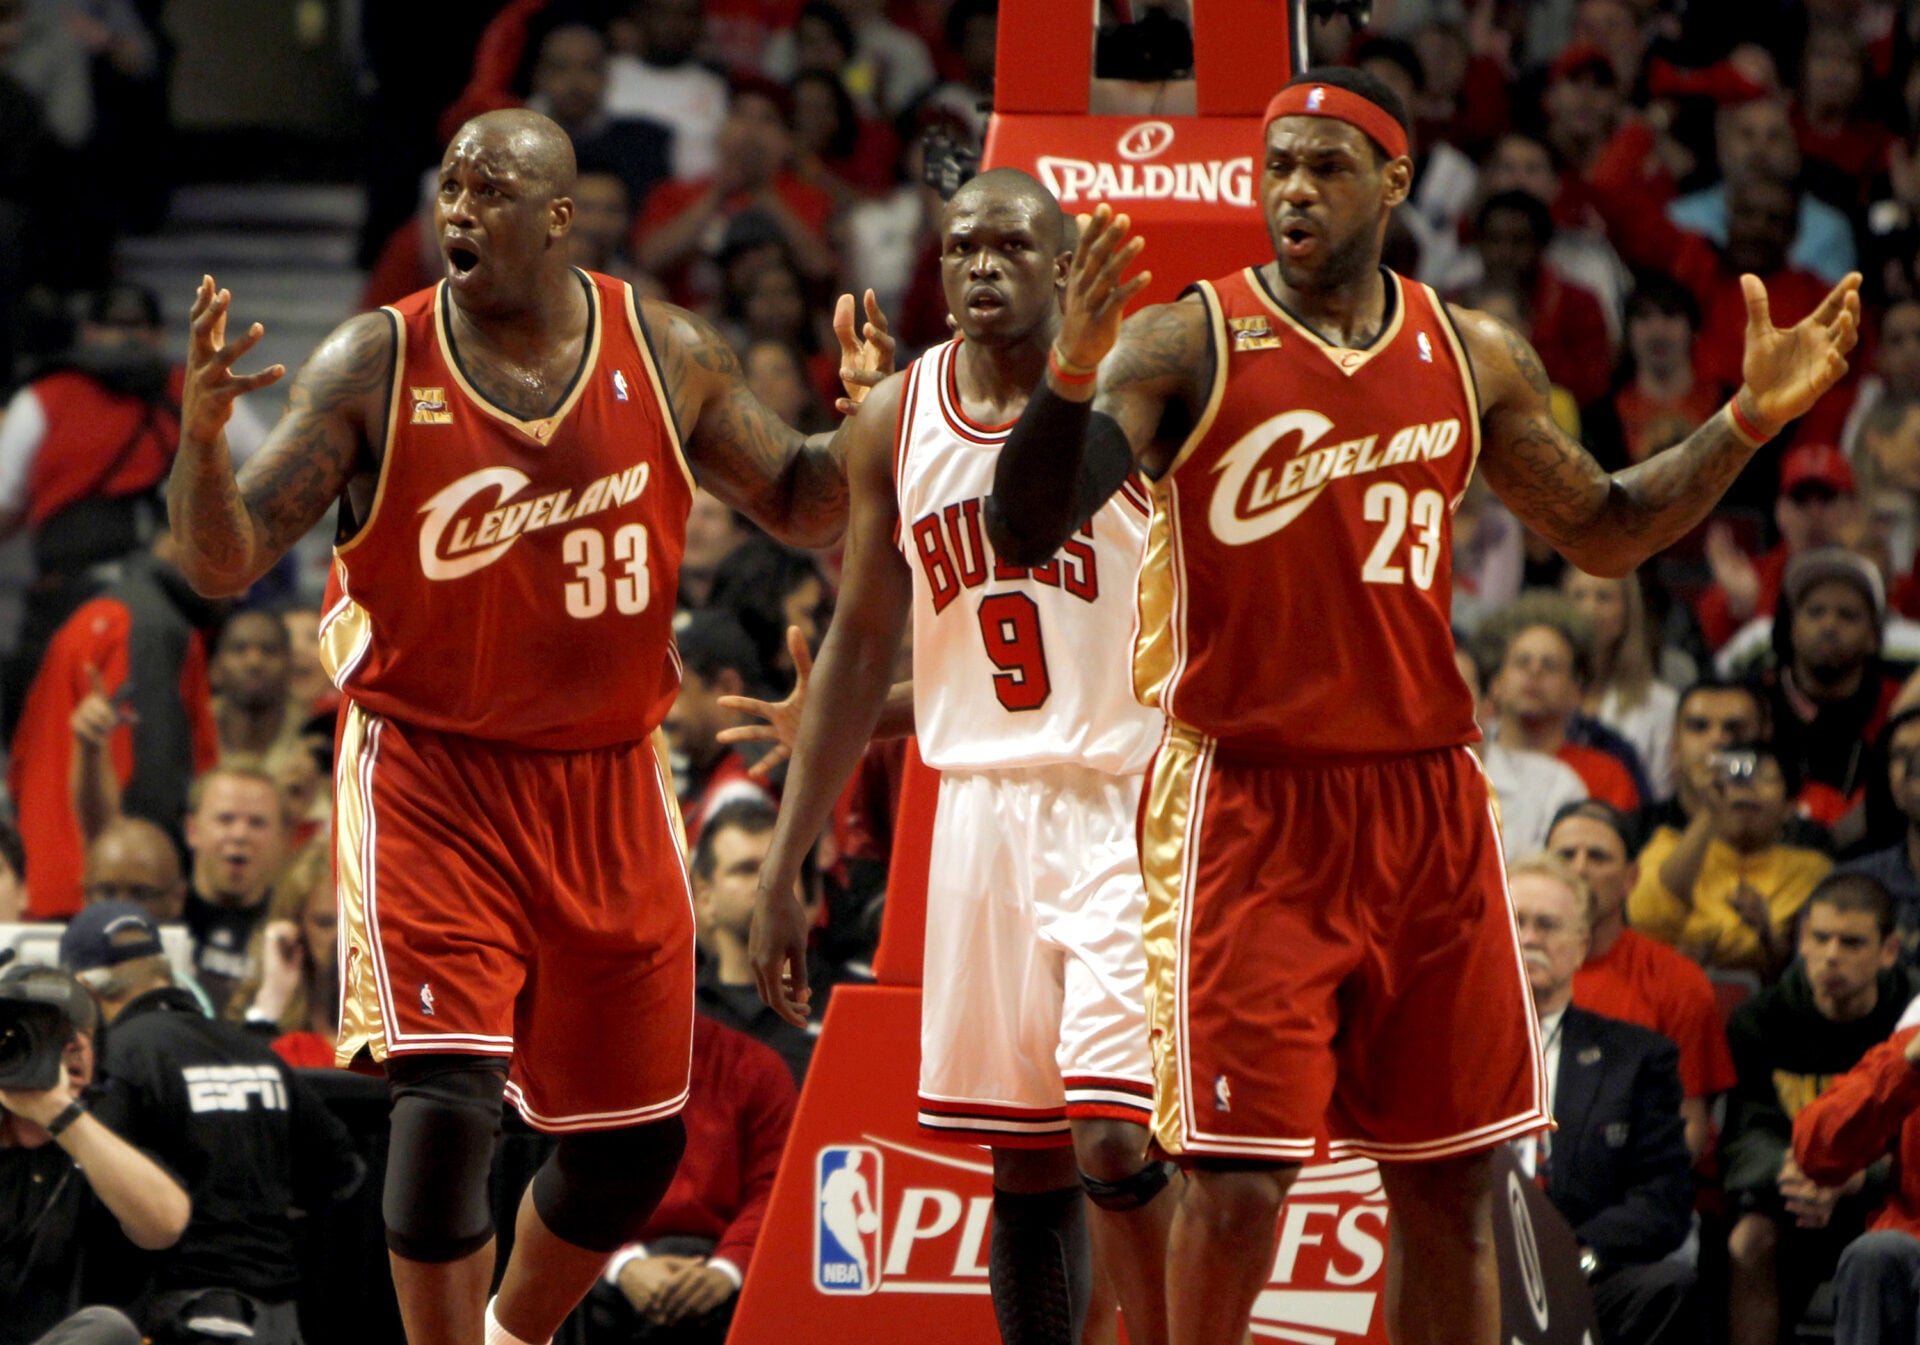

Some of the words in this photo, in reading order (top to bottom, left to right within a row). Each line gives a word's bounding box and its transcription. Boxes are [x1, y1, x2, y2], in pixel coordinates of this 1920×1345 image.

[1036, 155, 1254, 207] SPALDING
[417, 461, 650, 581] CLEVELAND
[1208, 409, 1461, 546] CLEVELAND
[562, 523, 651, 619] 33
[1361, 481, 1444, 591] 23
[977, 590, 1051, 713] 9
[181, 1065, 289, 1113] ESPN
[823, 1262, 860, 1284] NBA
